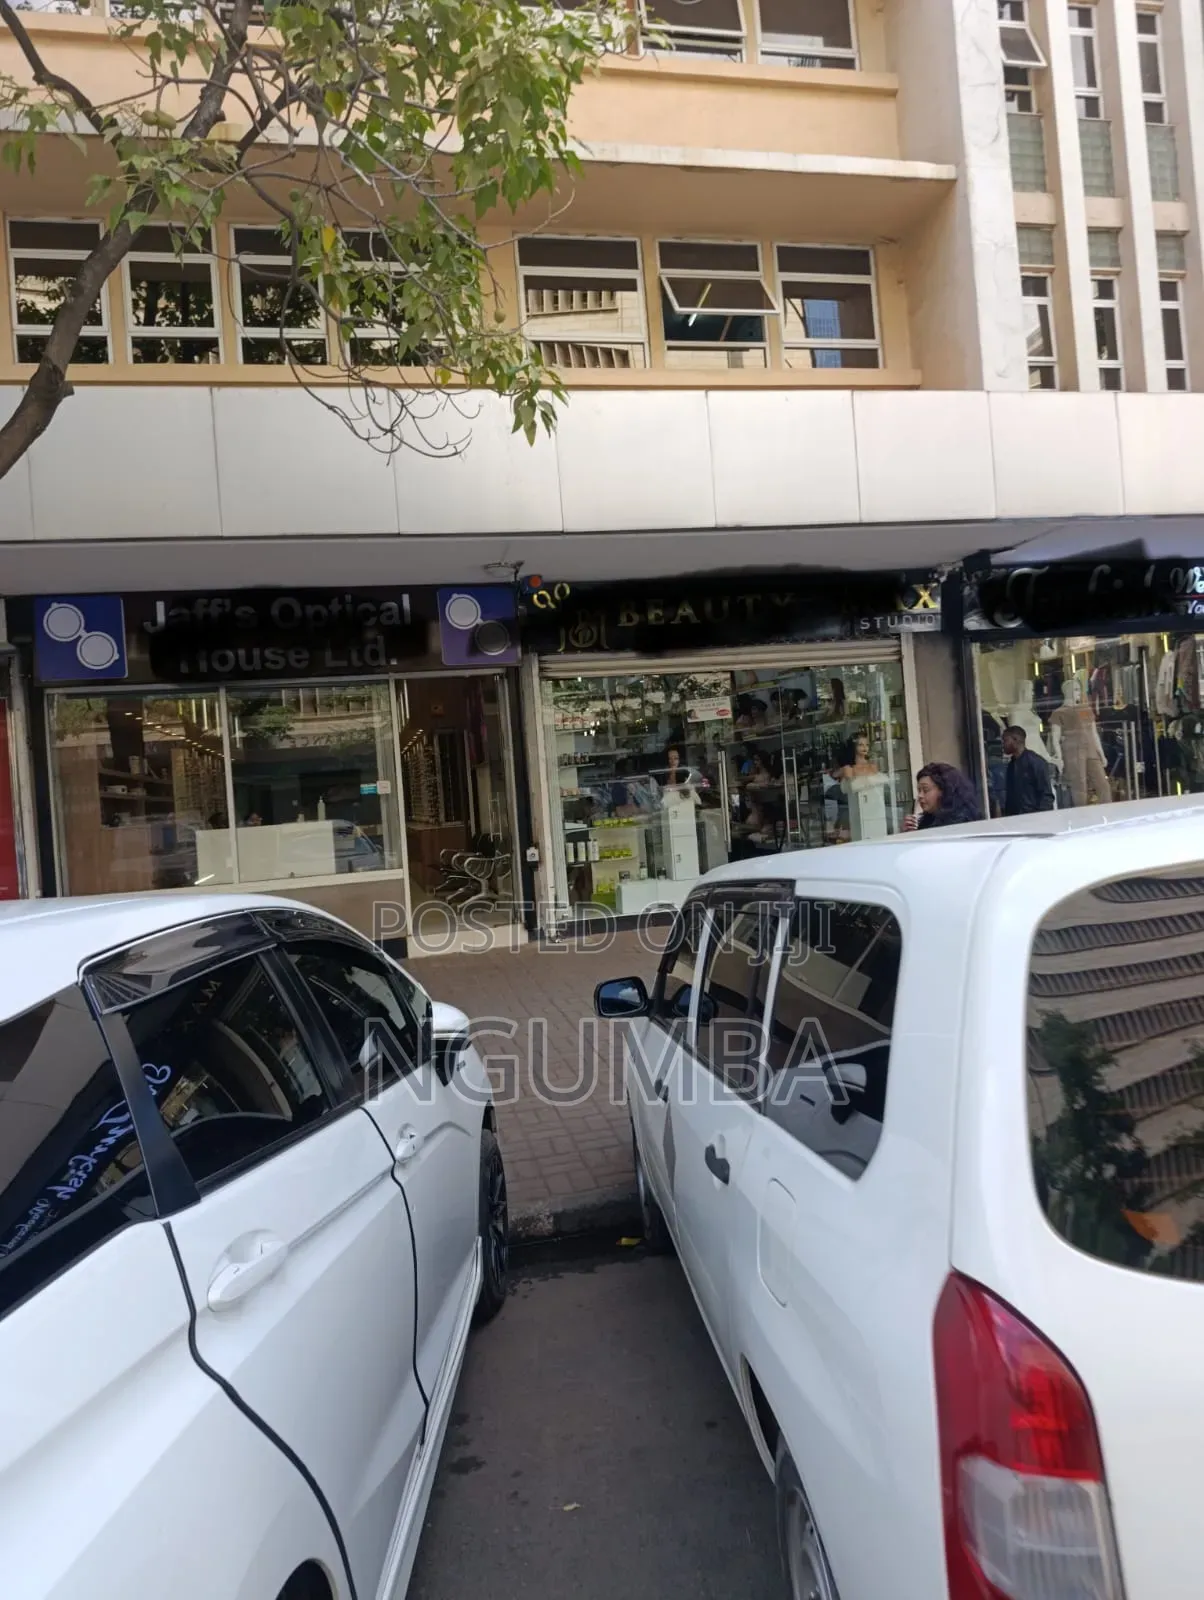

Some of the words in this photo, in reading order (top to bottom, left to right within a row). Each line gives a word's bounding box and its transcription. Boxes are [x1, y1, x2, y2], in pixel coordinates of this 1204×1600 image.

[270, 593, 412, 630] Optical
[616, 592, 798, 627] BEAUTY
[860, 614, 936, 630] STUDIO
[325, 636, 398, 668] Ltd.
